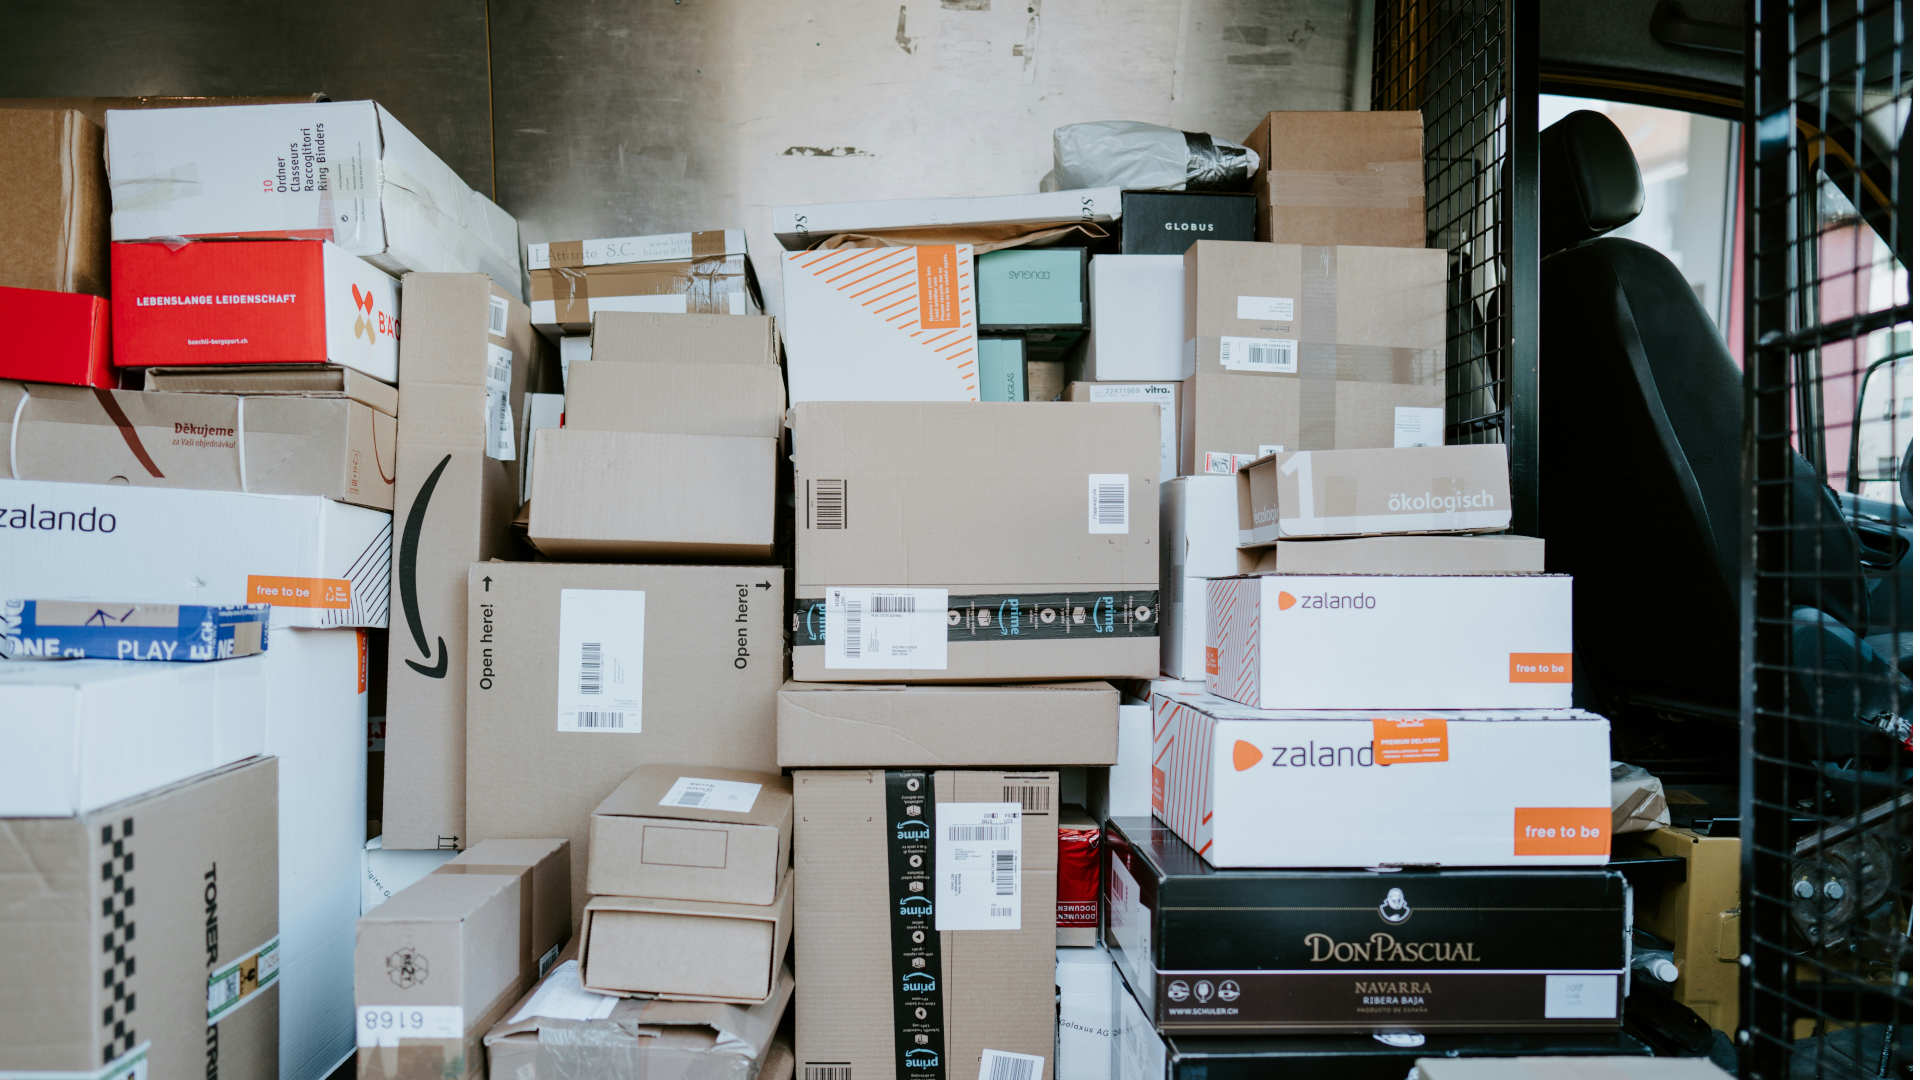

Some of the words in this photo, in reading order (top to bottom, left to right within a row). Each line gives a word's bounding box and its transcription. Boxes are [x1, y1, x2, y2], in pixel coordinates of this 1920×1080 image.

[315, 122, 327, 164] Binders
[289, 142, 301, 192] Classeurs
[301, 127, 314, 192] Raccoglitori
[276, 157, 287, 193] Ordner
[317, 166, 329, 191] Ring
[263, 179, 273, 194] 10
[1164, 222, 1215, 232] GLOBUS
[1008, 270, 1051, 280] DOUGLAS
[136, 295, 213, 307] LEBENSLANGE
[215, 294, 297, 305] LEIDENSCHAFT
[174, 422, 235, 438] Děkujeme
[1388, 489, 1495, 512] ökologisch
[0, 503, 117, 535] zalando
[256, 584, 279, 596] free
[281, 586, 293, 596] to
[295, 587, 310, 598] be
[735, 583, 749, 625] here!
[1301, 592, 1376, 610] zalando
[480, 603, 494, 642] here!
[1008, 598, 1020, 636] prime
[1103, 596, 1115, 634] prime
[117, 639, 178, 660] PLAY
[734, 627, 751, 670] Open
[480, 643, 497, 690] Open
[1516, 664, 1537, 673] free
[1539, 664, 1551, 673] to
[1552, 664, 1565, 673] be
[1272, 740, 1391, 768] zaland
[896, 827, 930, 841] prime
[1525, 826, 1556, 839] free
[1560, 826, 1576, 839] to
[1578, 826, 1600, 839] be
[204, 862, 218, 968] TONER
[900, 903, 933, 917] prime
[903, 979, 936, 993] prime
[1354, 981, 1433, 994] NAVARRA
[1362, 996, 1399, 1005] RIBERA
[1401, 996, 1425, 1005] BAJA
[364, 1011, 424, 1029] 6168
[1168, 1008, 1239, 1016] WWW.SCHULER.CH
[1059, 1017, 1094, 1033] Galaxus
[905, 1055, 939, 1069] prime
